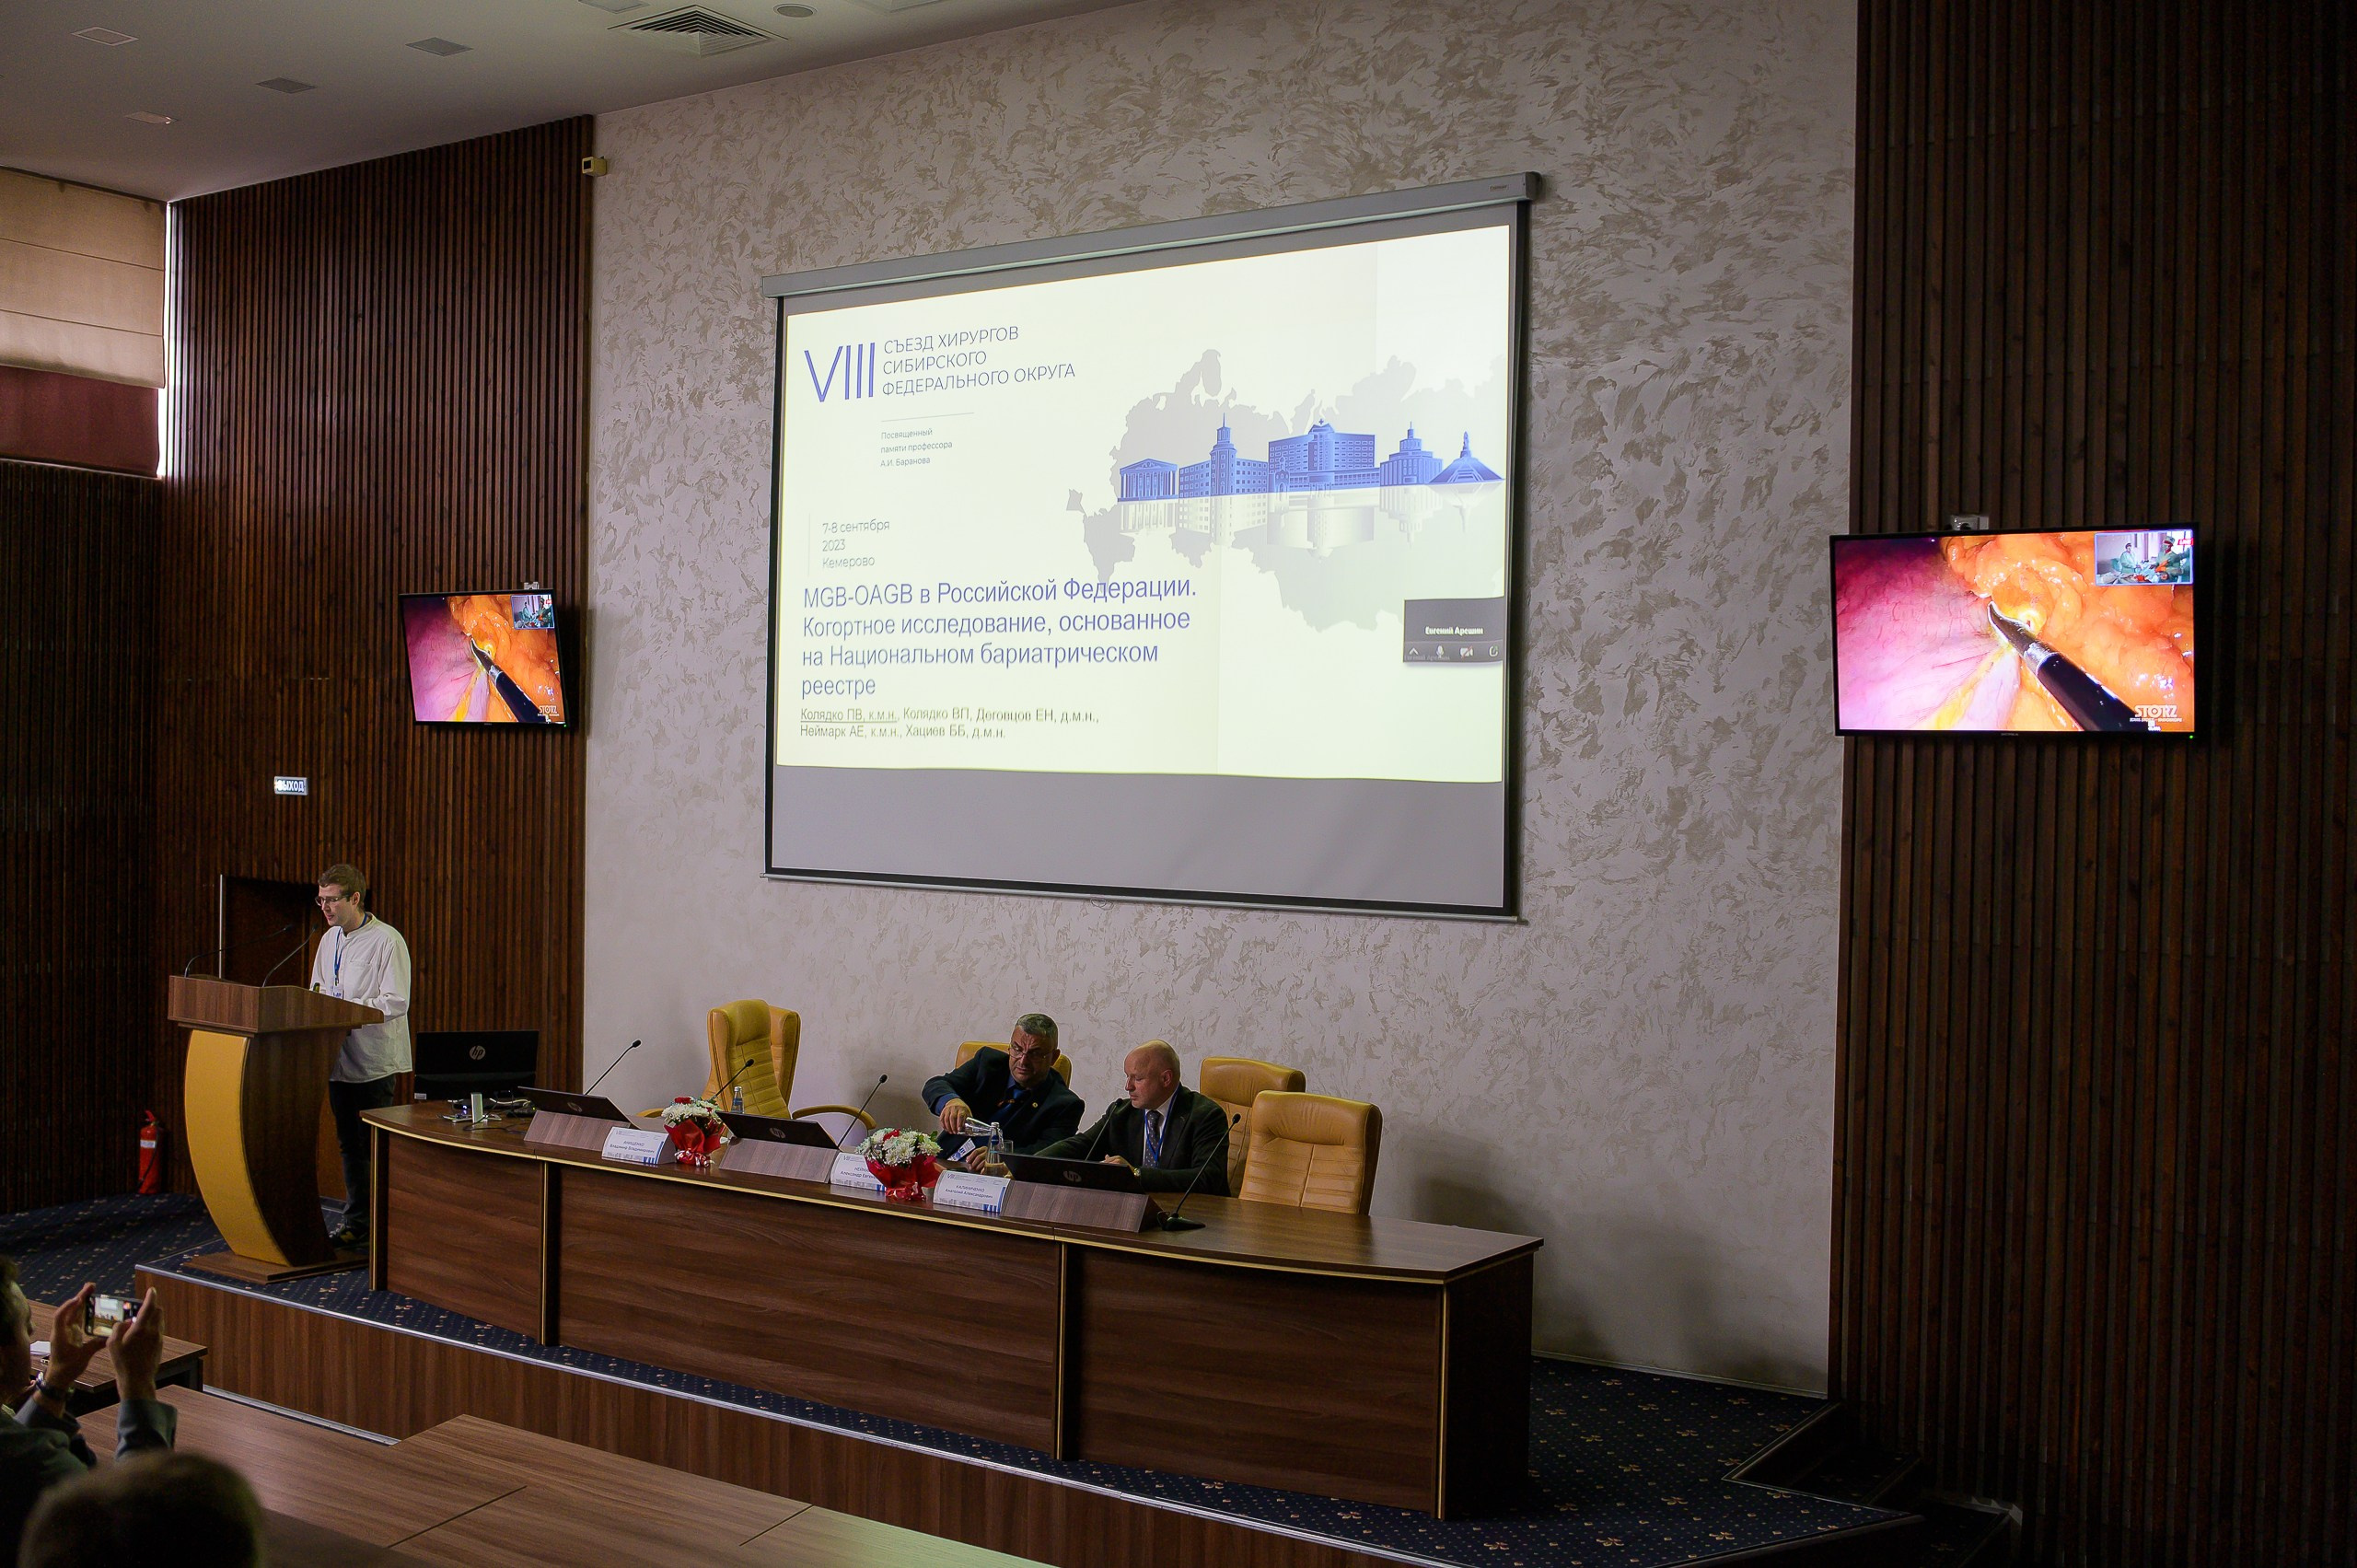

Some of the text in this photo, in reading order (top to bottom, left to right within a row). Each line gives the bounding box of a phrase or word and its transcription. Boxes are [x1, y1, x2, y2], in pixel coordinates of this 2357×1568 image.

[884, 326, 1019, 354] СЪЕЗД ХИРУРГОВ
[882, 351, 987, 375] СИБИРСКОГО
[804, 343, 875, 402] VIII
[882, 363, 1075, 397] ФЕДЕРАЛЬНОГО ОКРУГА
[881, 428, 933, 441] Посвященный
[881, 440, 953, 454] памяти профессора
[895, 456, 931, 468] Баранова
[822, 518, 890, 534] 7-8 сентября
[822, 539, 846, 552] 2023
[822, 555, 875, 570] Кемерово
[804, 578, 1197, 608] MGB-OAGB в Российской Федерации.
[803, 612, 1190, 641] Когортное исследование, основанное
[802, 642, 1158, 669] на Национальном бариатрическом
[801, 676, 877, 700] реестре
[801, 708, 844, 722] Колядко
[847, 708, 865, 722] ПВ,
[903, 707, 948, 721] Колядко
[952, 707, 972, 721] ВП,
[1035, 708, 1057, 723] ЕН,
[1060, 711, 1099, 724] д.м.н.,
[2135, 705, 2177, 718] STORZ
[801, 724, 846, 740] Неймарк
[849, 725, 867, 739] АЕ,
[871, 727, 902, 739] к.м.н.,
[949, 723, 969, 738] ББ,
[972, 726, 1006, 739] д.м.н.
